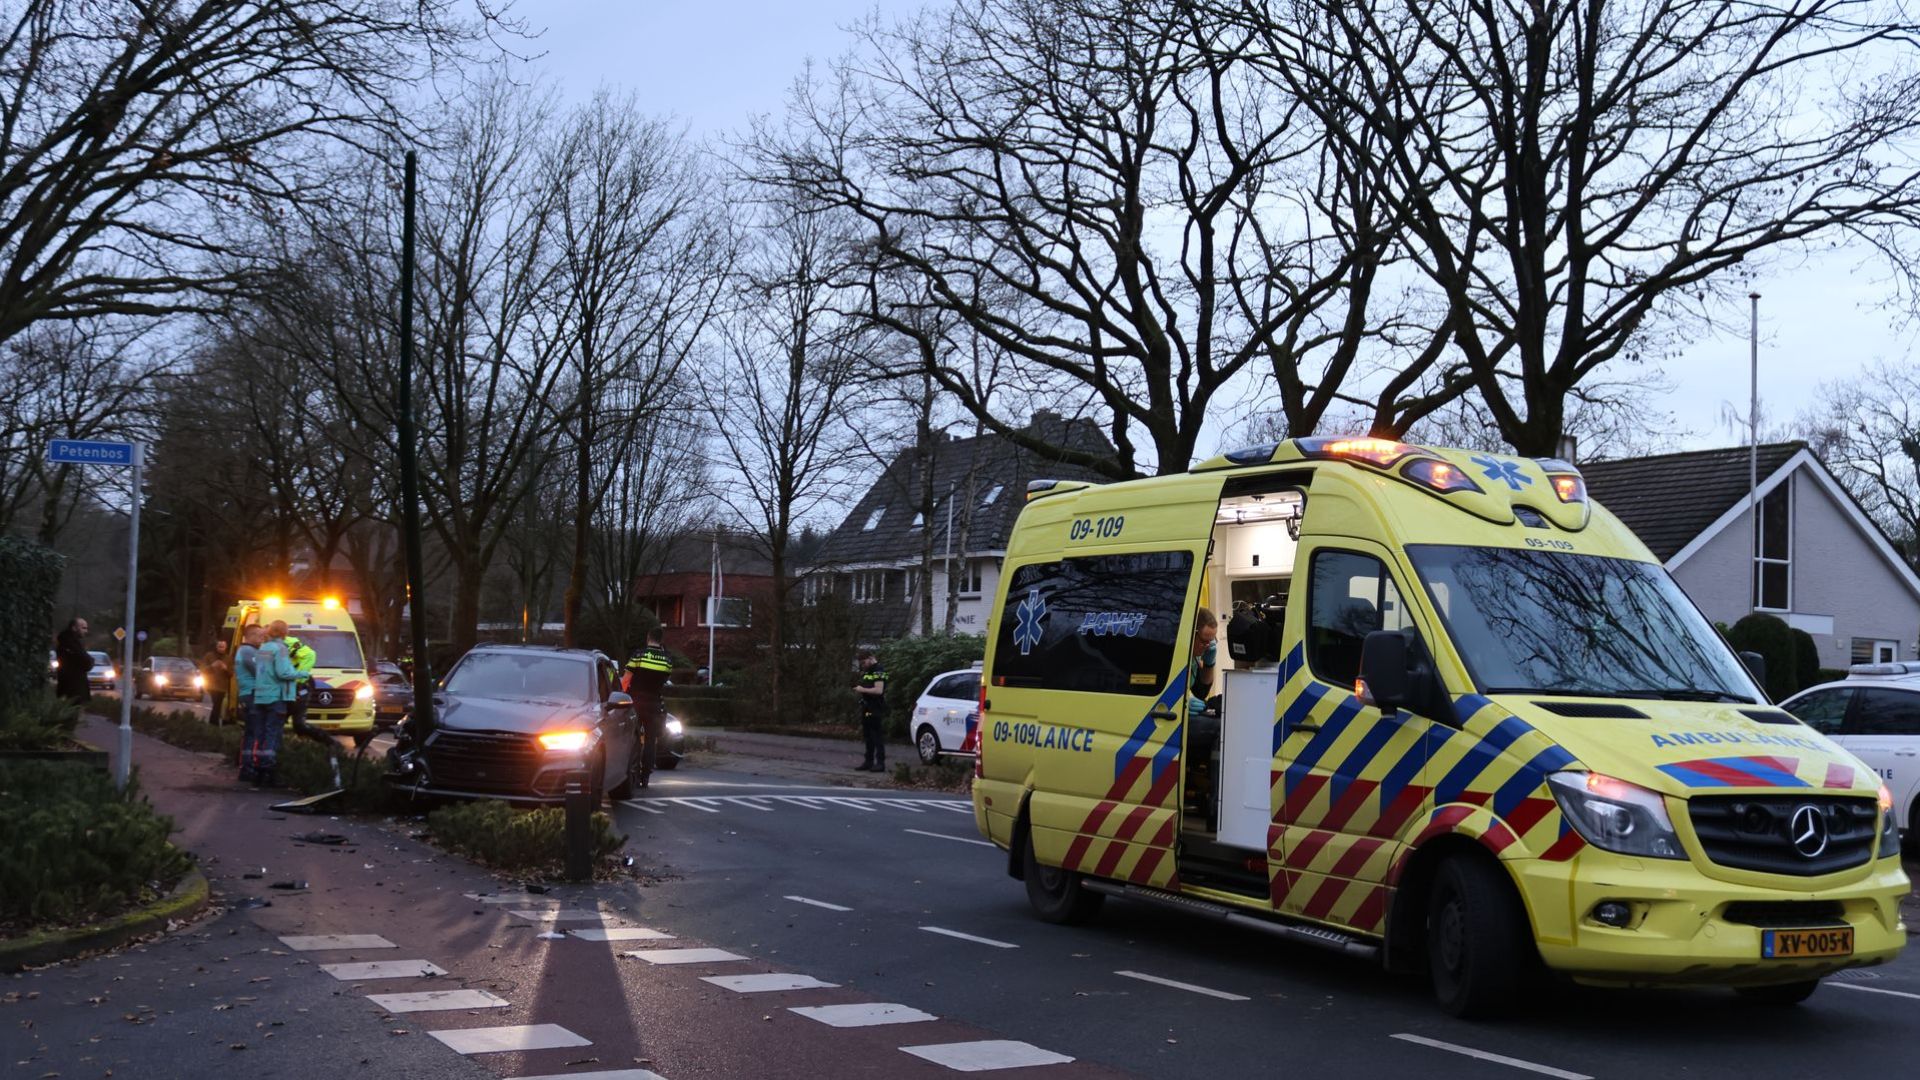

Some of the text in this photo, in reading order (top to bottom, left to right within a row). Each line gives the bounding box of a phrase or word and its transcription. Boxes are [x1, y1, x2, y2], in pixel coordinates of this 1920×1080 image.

[59, 445, 124, 459] Petenbos
[1070, 515, 1125, 540] 09-109
[1524, 537, 1574, 550] 09-109
[1779, 931, 1850, 954] XV-005-K
